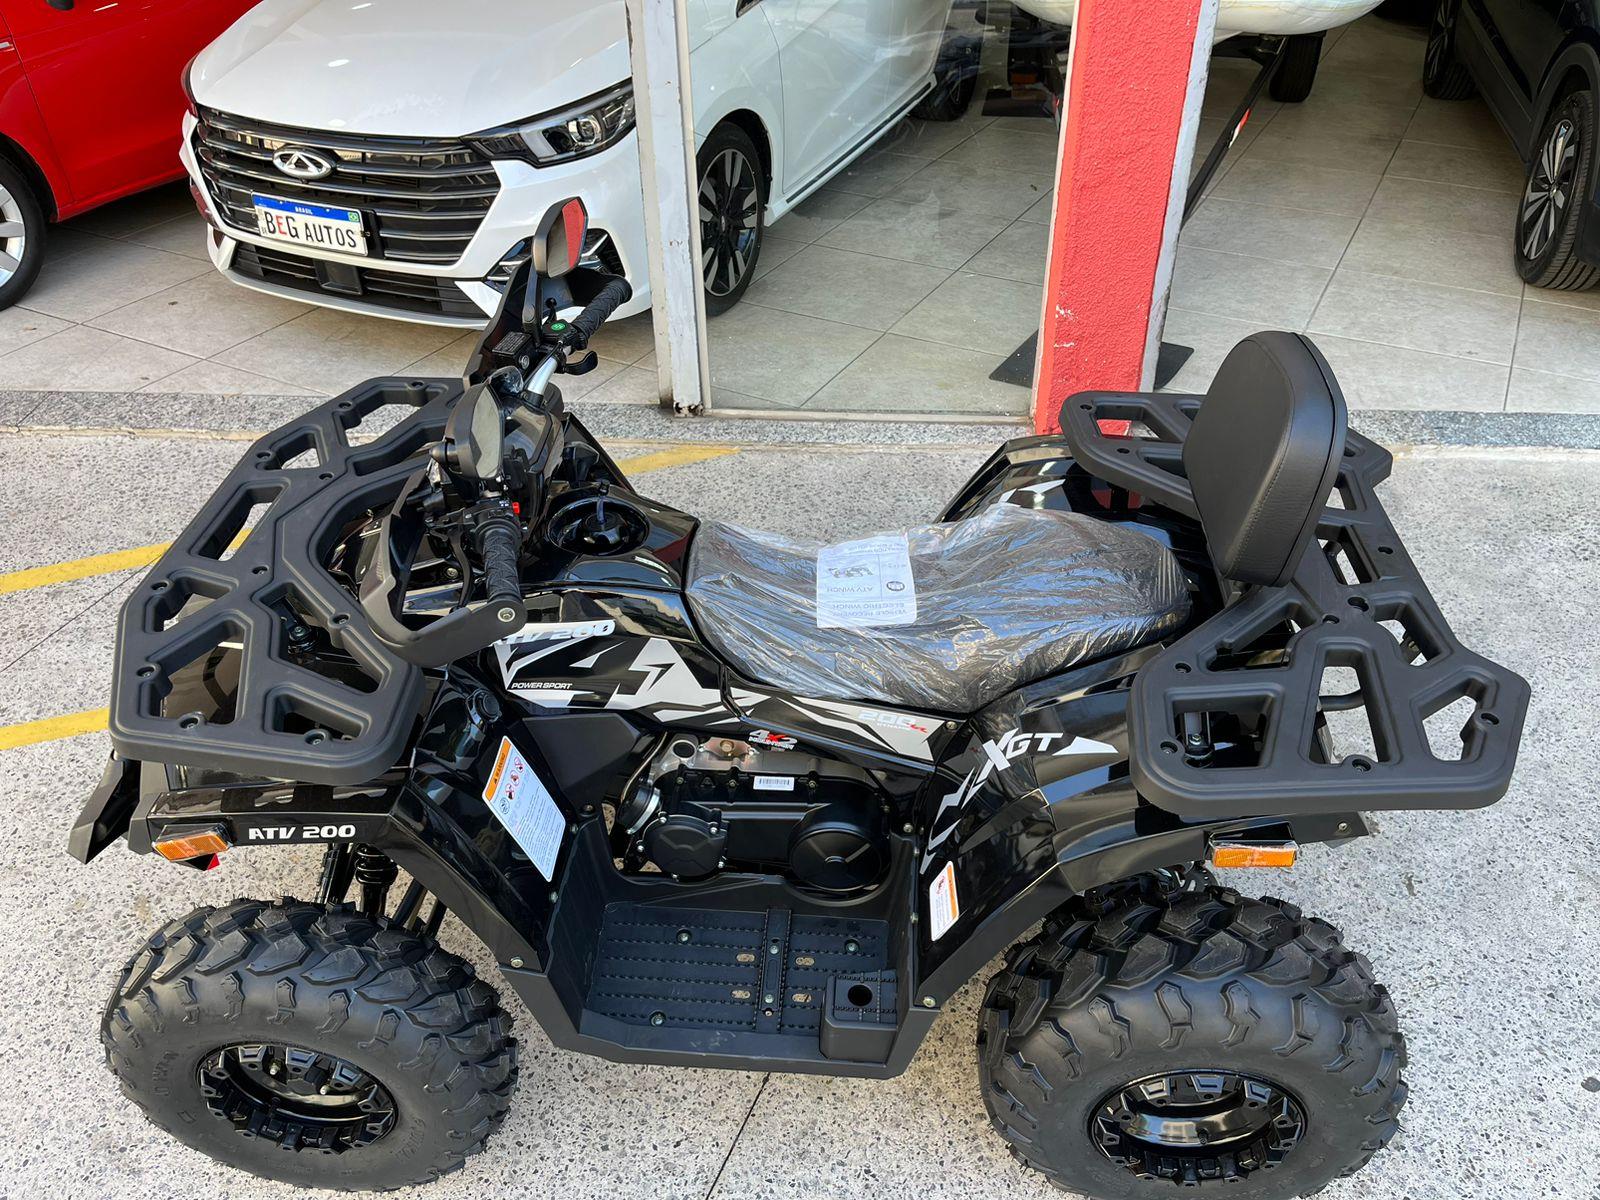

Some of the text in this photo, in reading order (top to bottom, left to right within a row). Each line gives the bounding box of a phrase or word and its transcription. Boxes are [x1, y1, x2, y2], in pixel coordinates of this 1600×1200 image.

[295, 206, 313, 215] BRASIL
[264, 210, 357, 248] BEG AUTOS
[543, 682, 573, 690] SPORT
[977, 728, 1064, 776] XGT
[248, 824, 356, 840] ATV 200
